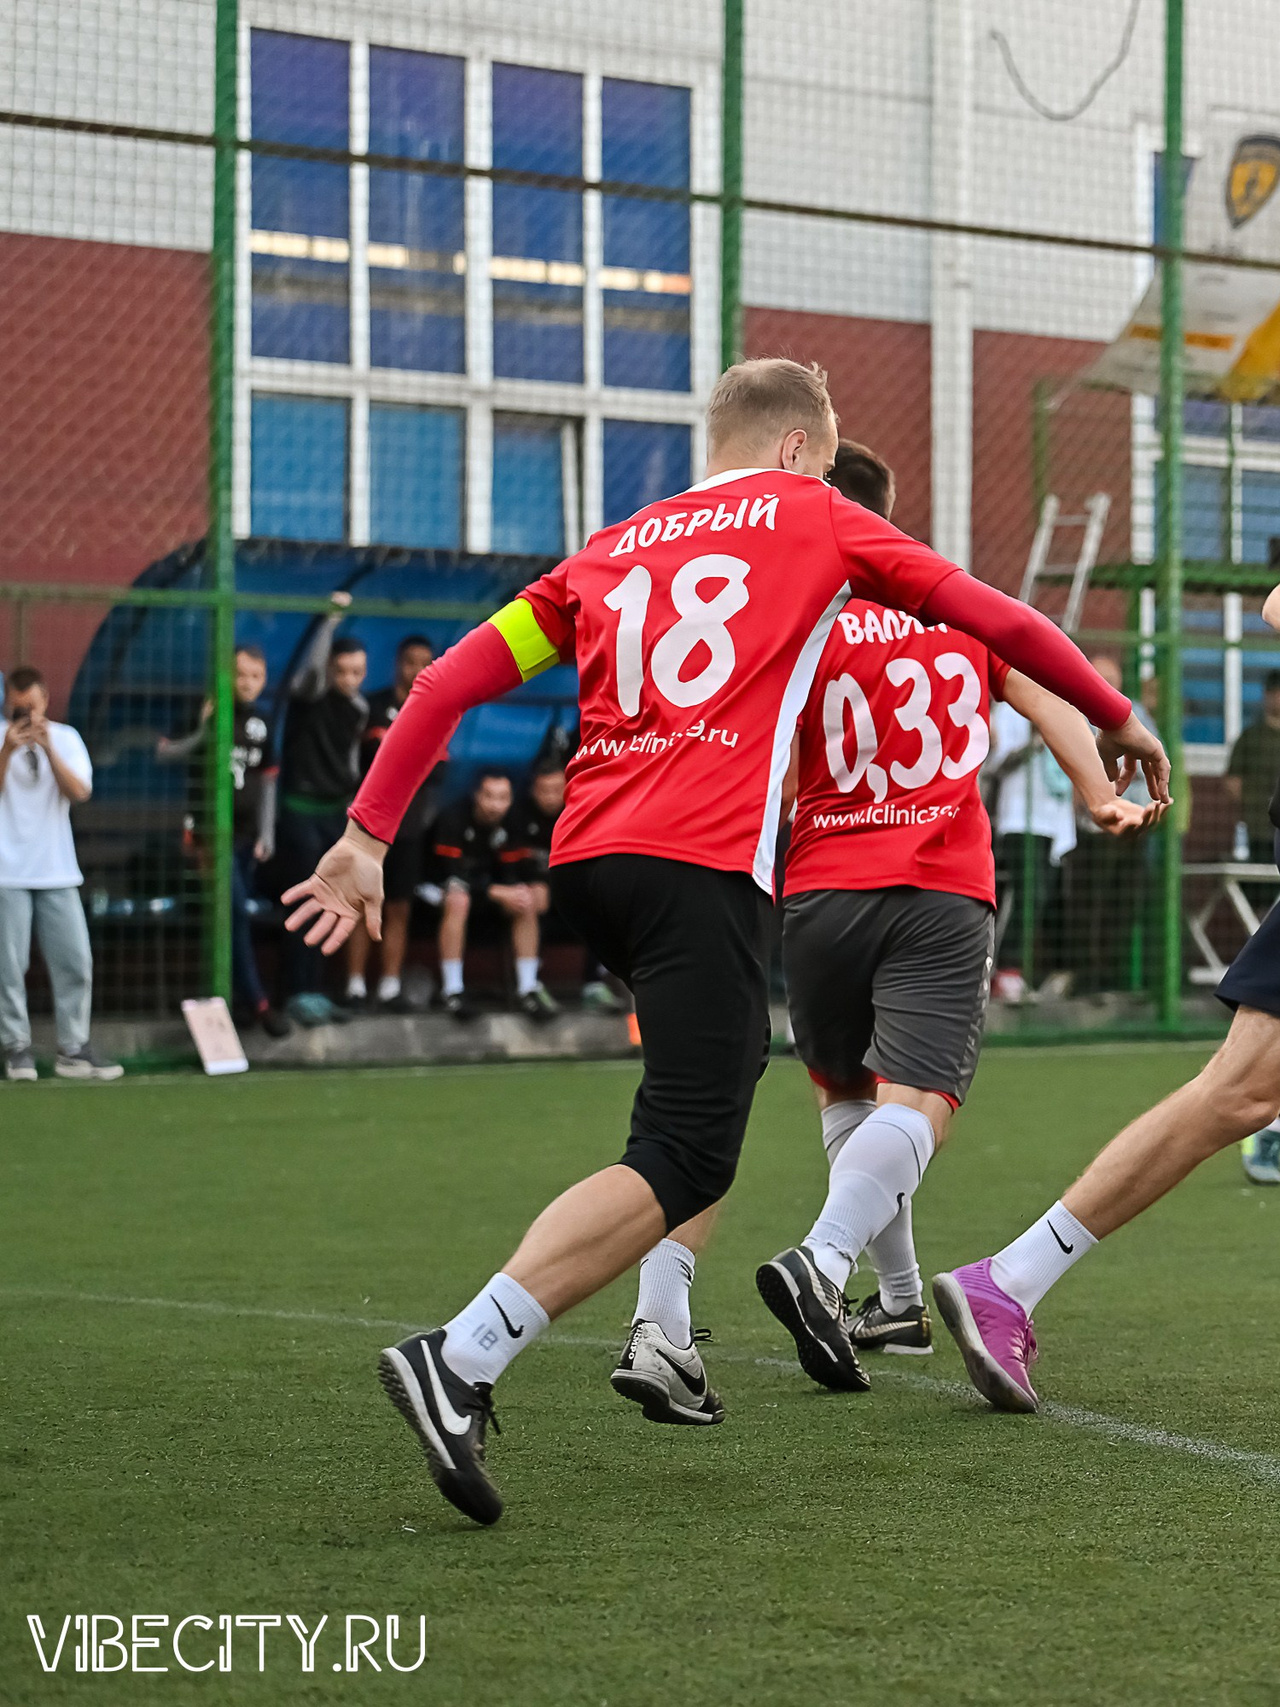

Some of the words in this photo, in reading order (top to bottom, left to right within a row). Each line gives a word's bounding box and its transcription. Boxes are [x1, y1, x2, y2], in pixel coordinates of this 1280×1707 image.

[608, 493, 780, 558] ДОБРЫЙ
[603, 553, 751, 718] 18
[822, 651, 990, 804] 0,33
